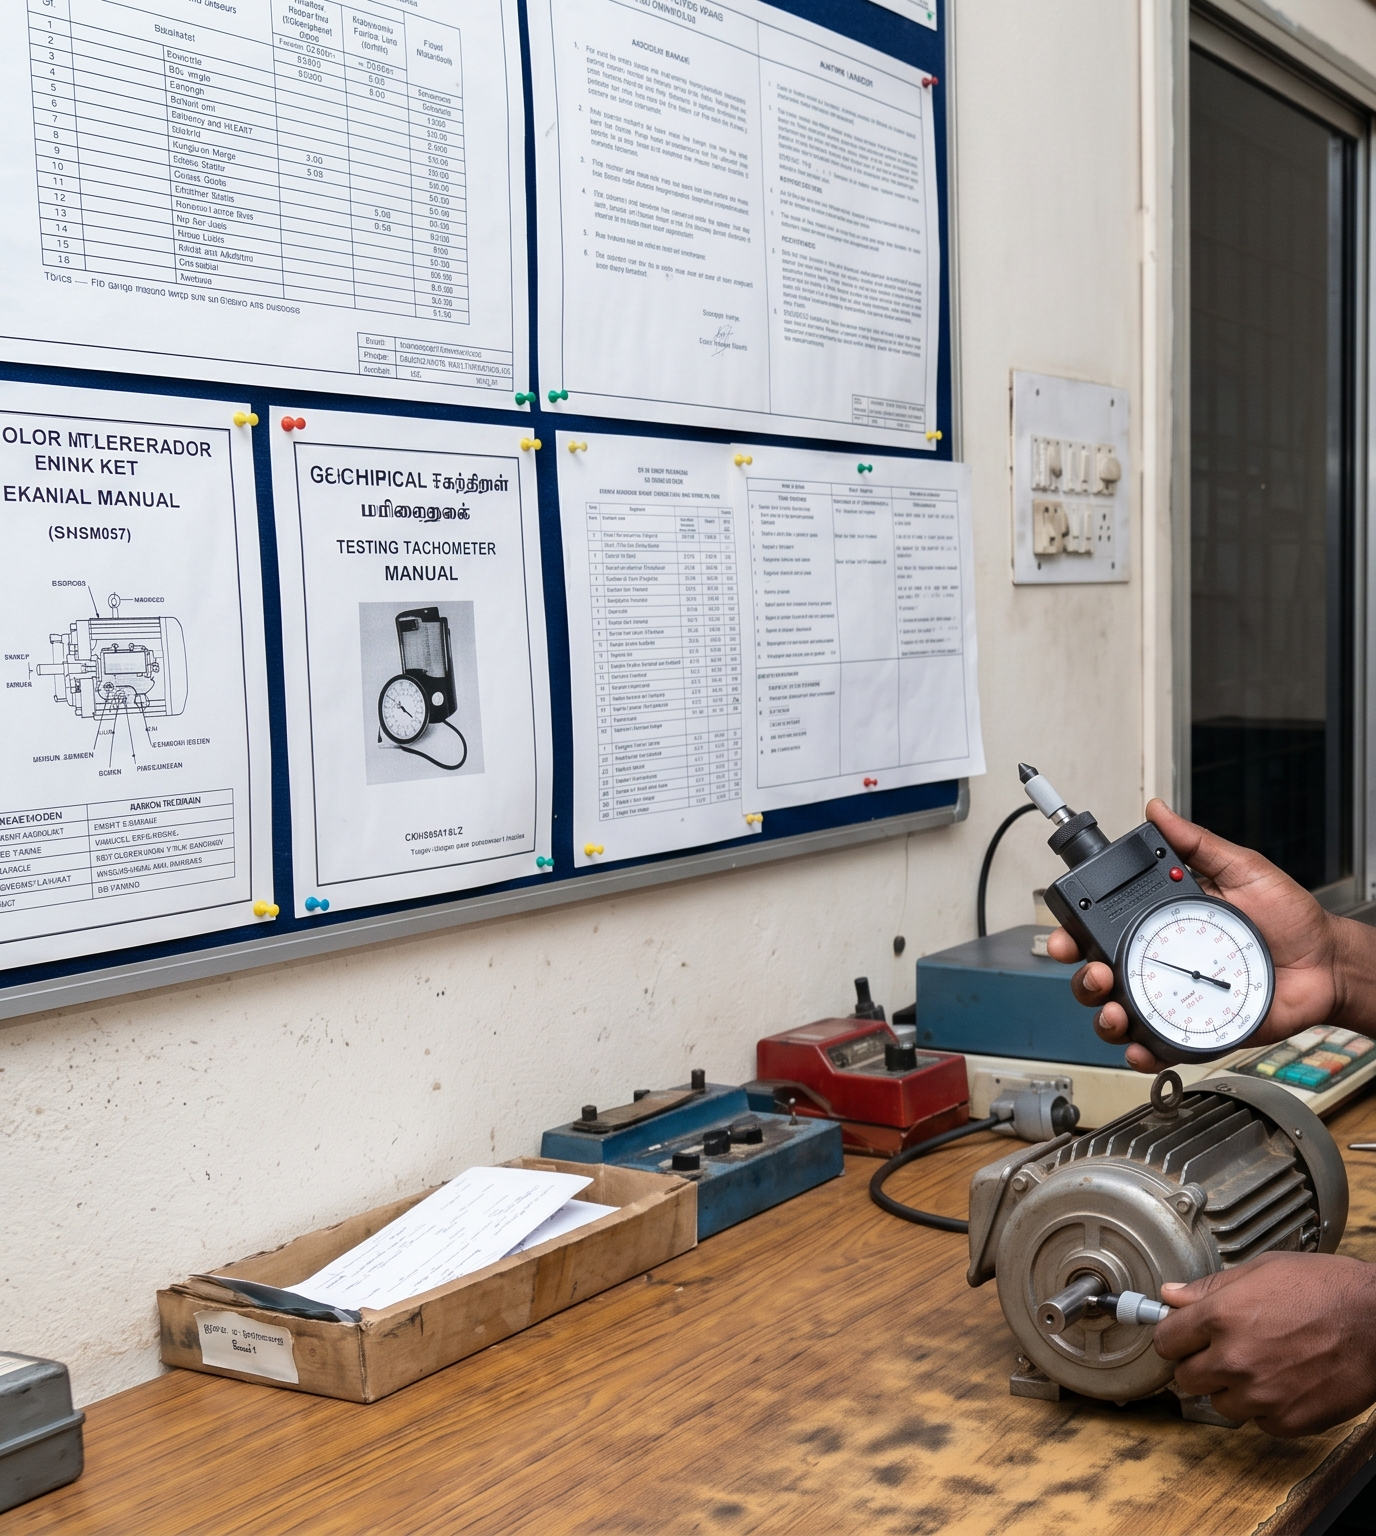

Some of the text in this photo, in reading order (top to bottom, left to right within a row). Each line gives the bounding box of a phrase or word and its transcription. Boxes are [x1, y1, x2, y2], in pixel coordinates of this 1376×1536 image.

[48, 20, 52, 29] 1
[48, 36, 54, 45] 2
[48, 52, 54, 61] 3
[50, 67, 55, 76] 4
[50, 83, 56, 92] 5
[51, 99, 58, 108] 6
[52, 114, 58, 122] 7
[207, 118, 222, 129] and
[53, 130, 59, 139] 8
[54, 146, 60, 154] 9
[212, 148, 236, 161] Merge
[306, 154, 323, 164] 3.00
[52, 162, 64, 170] 10
[53, 178, 64, 186] 11
[54, 192, 66, 202] 12
[55, 208, 67, 218] 13
[56, 224, 68, 232] 14
[57, 240, 70, 248] 15
[2, 426, 62, 447] OLOR
[34, 454, 139, 476] ENINK KET
[3, 485, 181, 509] EKANIAL MANUAL
[336, 539, 496, 556] TESTING TACHOMETER
[384, 565, 458, 582] MANUAL
